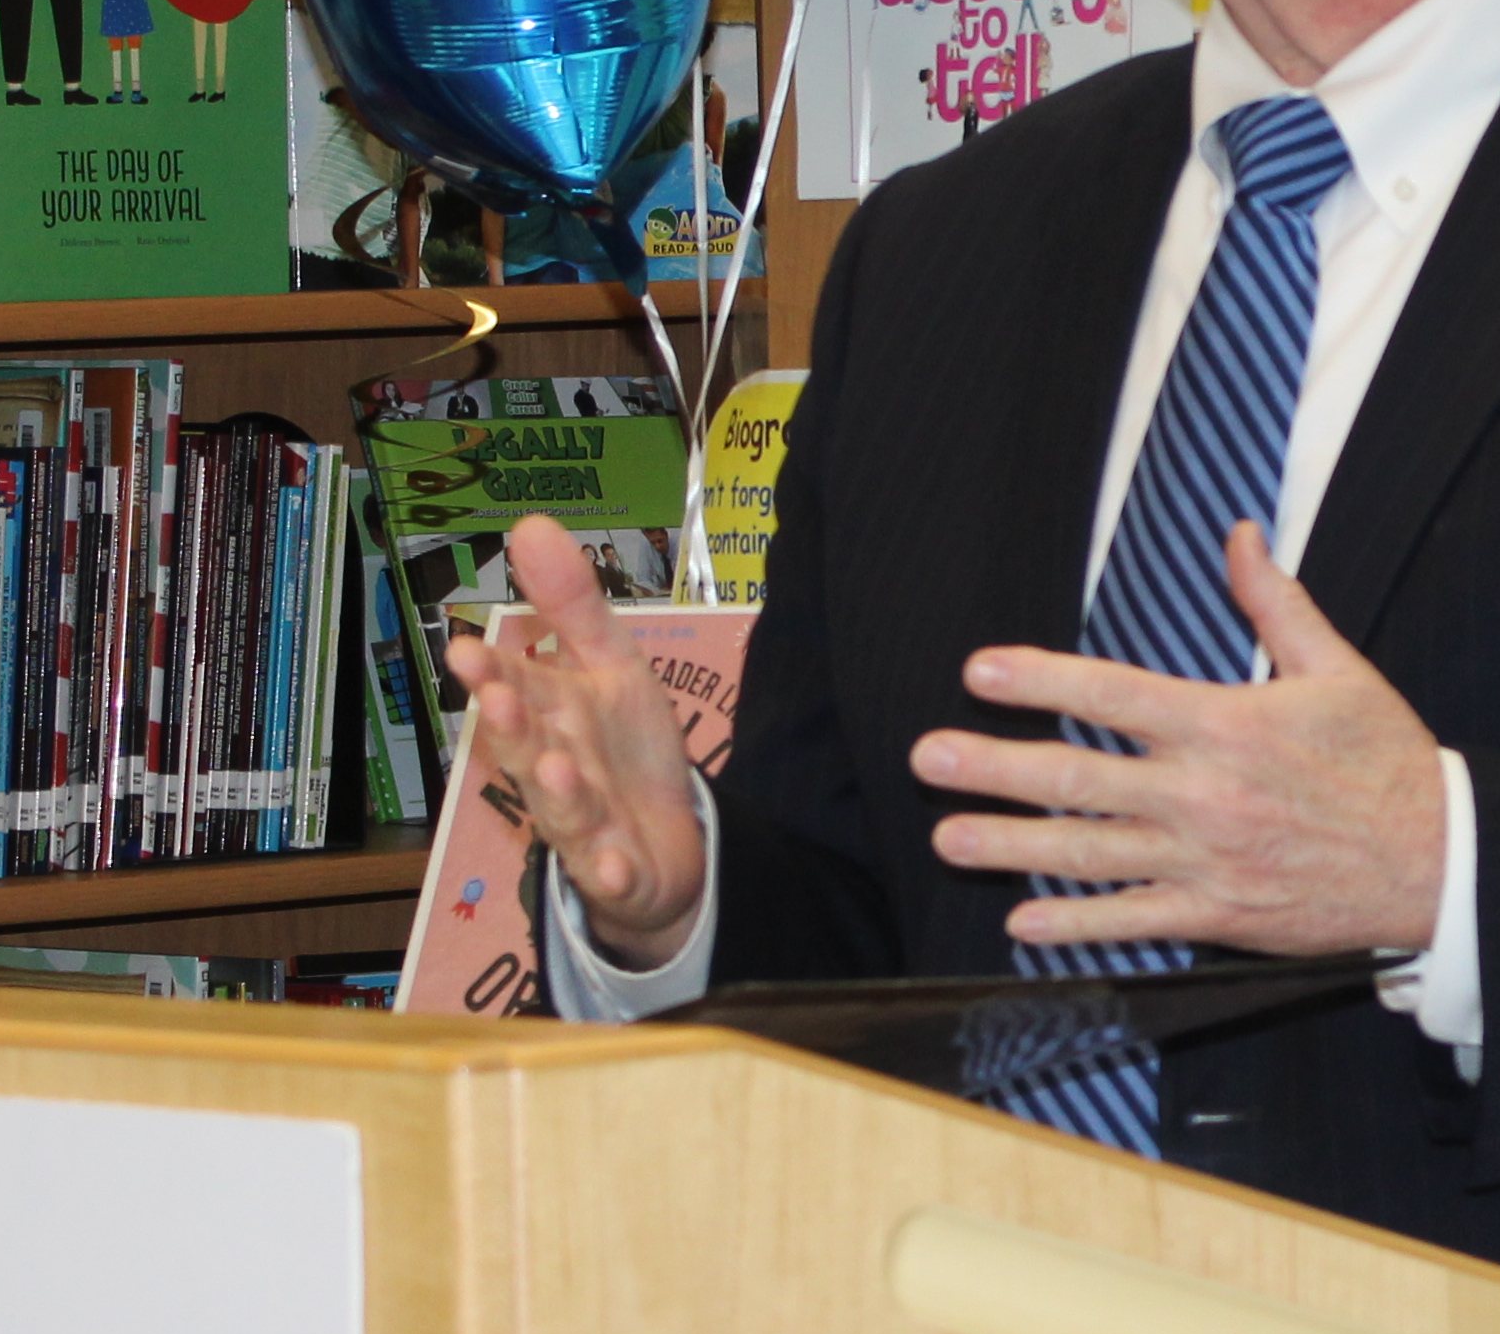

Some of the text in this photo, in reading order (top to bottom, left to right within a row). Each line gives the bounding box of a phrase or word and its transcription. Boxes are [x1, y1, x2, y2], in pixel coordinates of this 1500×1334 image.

[956, 0, 1008, 49] to
[936, 33, 1050, 123] tell
[57, 149, 185, 184] THE DAY OF
[42, 187, 207, 229] YOUR ARRIVAL
[653, 243, 734, 254] READ-AOUD
[452, 425, 605, 461] LEGALLY
[481, 465, 603, 502] GREEN
